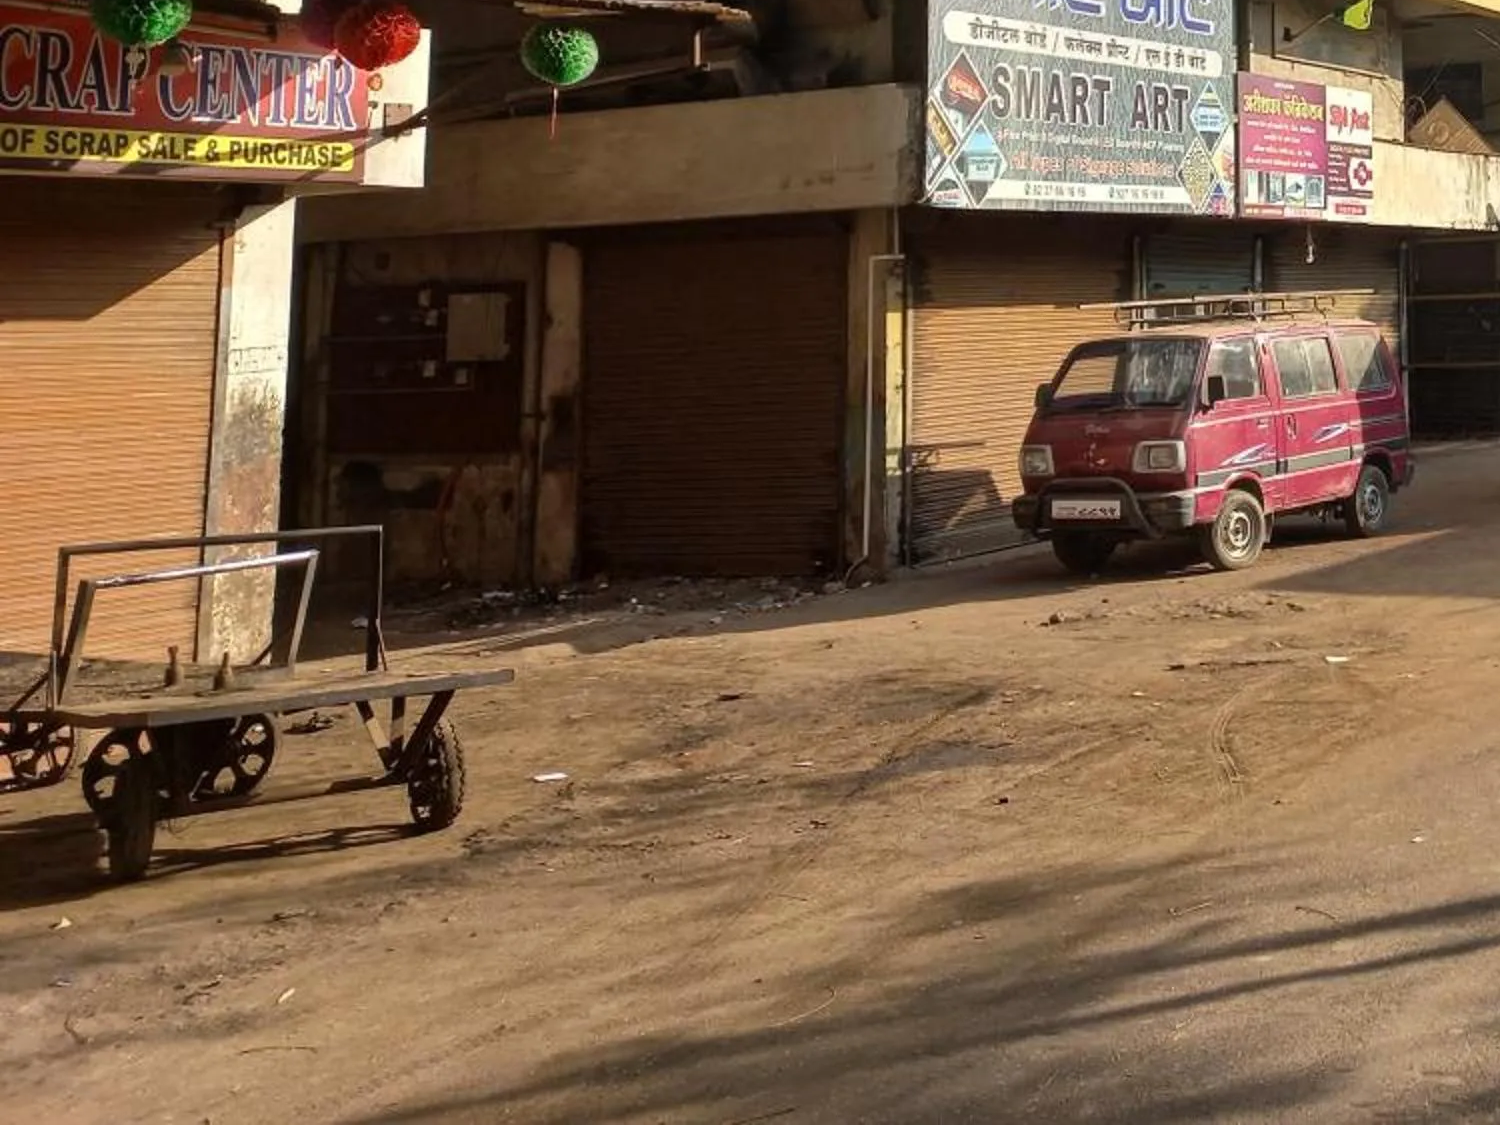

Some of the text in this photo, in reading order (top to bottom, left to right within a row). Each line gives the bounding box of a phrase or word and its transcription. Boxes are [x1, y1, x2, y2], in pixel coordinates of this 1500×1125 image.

[157, 39, 356, 131] CENTER
[990, 63, 1113, 129] SMART
[1129, 81, 1192, 135] ART
[0, 127, 344, 168] OF SCRAP SALE & PURCHASE
